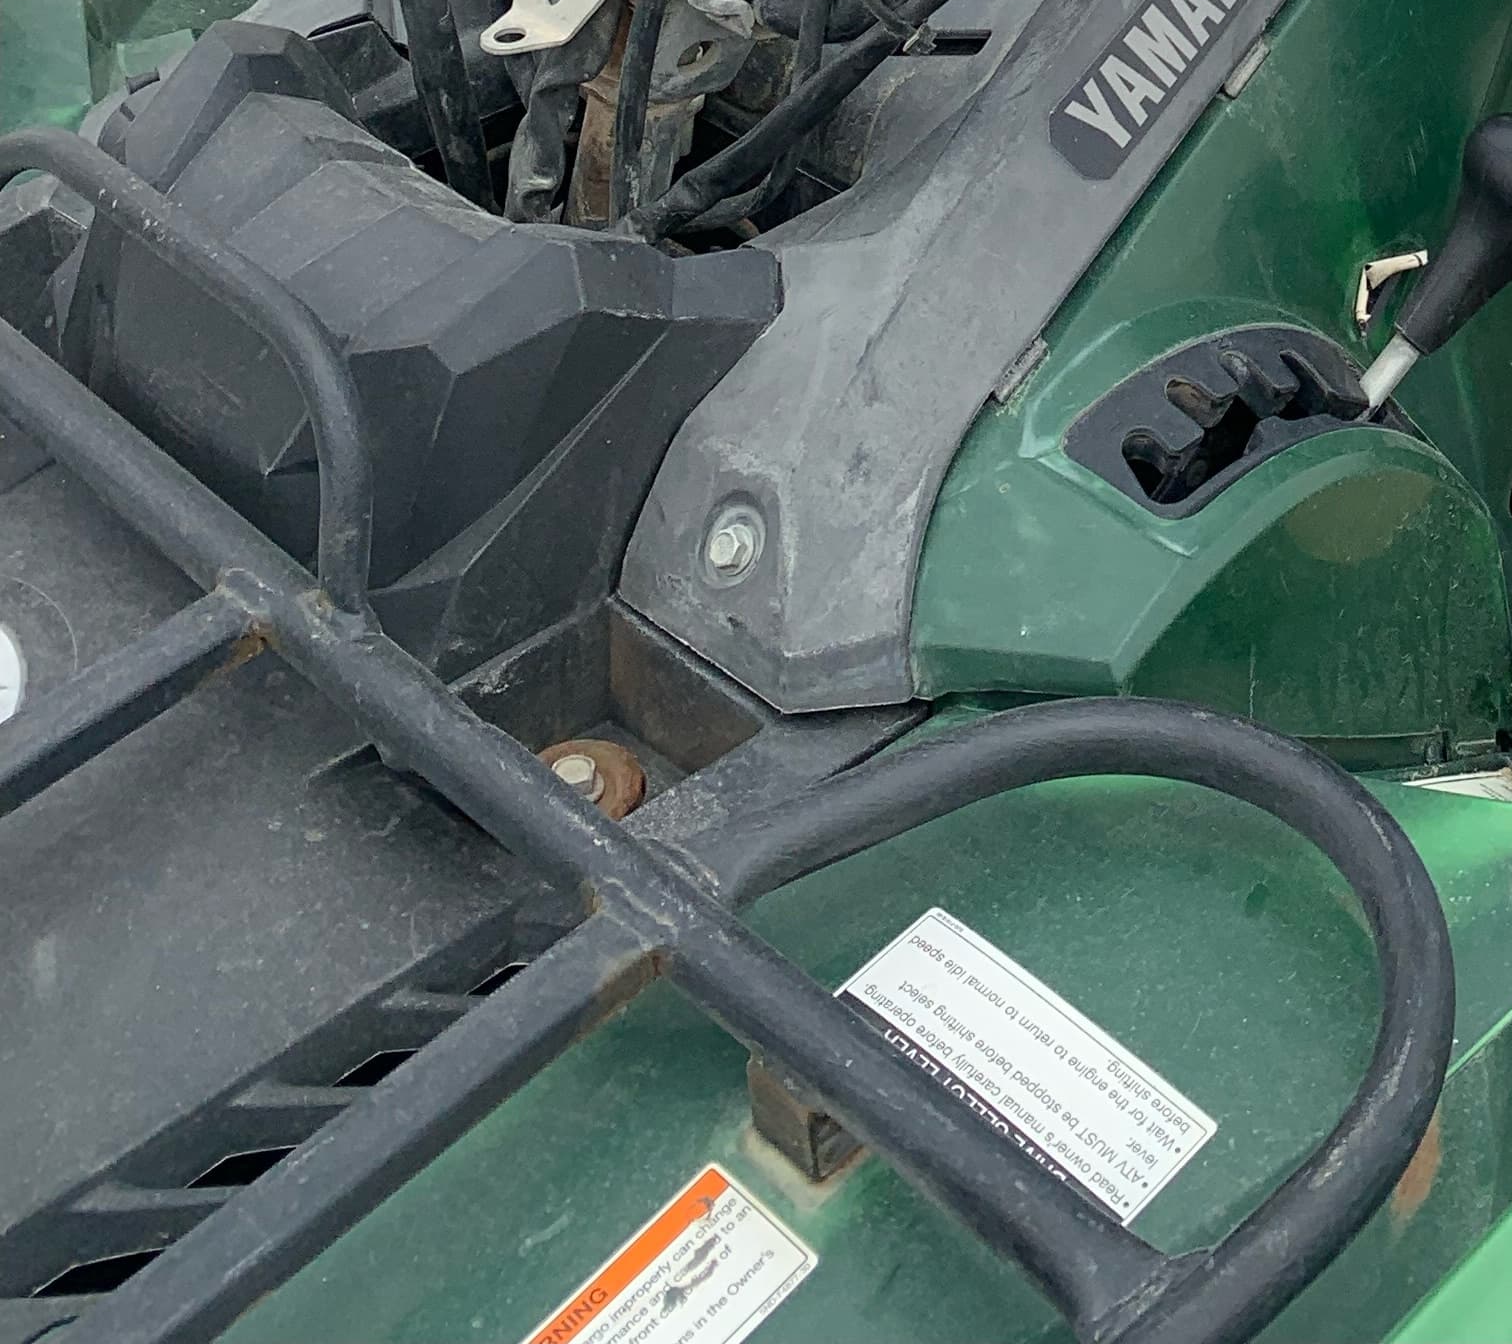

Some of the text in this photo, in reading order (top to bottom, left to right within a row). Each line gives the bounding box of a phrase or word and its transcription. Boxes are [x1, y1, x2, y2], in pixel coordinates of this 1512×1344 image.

[861, 982, 917, 1027] operating.
[908, 933, 1176, 1149] Wait for the engine to return to normal idle speed
[913, 1025, 952, 1056] before
[898, 981, 1144, 1184] ATV MUST be stopped before shifting select
[950, 1053, 1003, 1096] carefully
[1101, 1059, 1190, 1133] before shifting.
[998, 1095, 1045, 1132] manual
[1042, 1132, 1092, 1173] owner's
[1122, 1138, 1158, 1168] lever.
[1088, 1172, 1124, 1203] Read
[609, 1261, 670, 1321] improperly
[671, 1239, 694, 1262] can
[694, 1197, 737, 1239] change
[646, 1280, 673, 1307] and
[719, 1219, 735, 1234] to
[733, 1204, 751, 1221] an
[716, 1244, 733, 1260] of
[691, 1314, 707, 1329] in
[705, 1293, 728, 1316] the
[726, 1248, 773, 1294] Owner's
